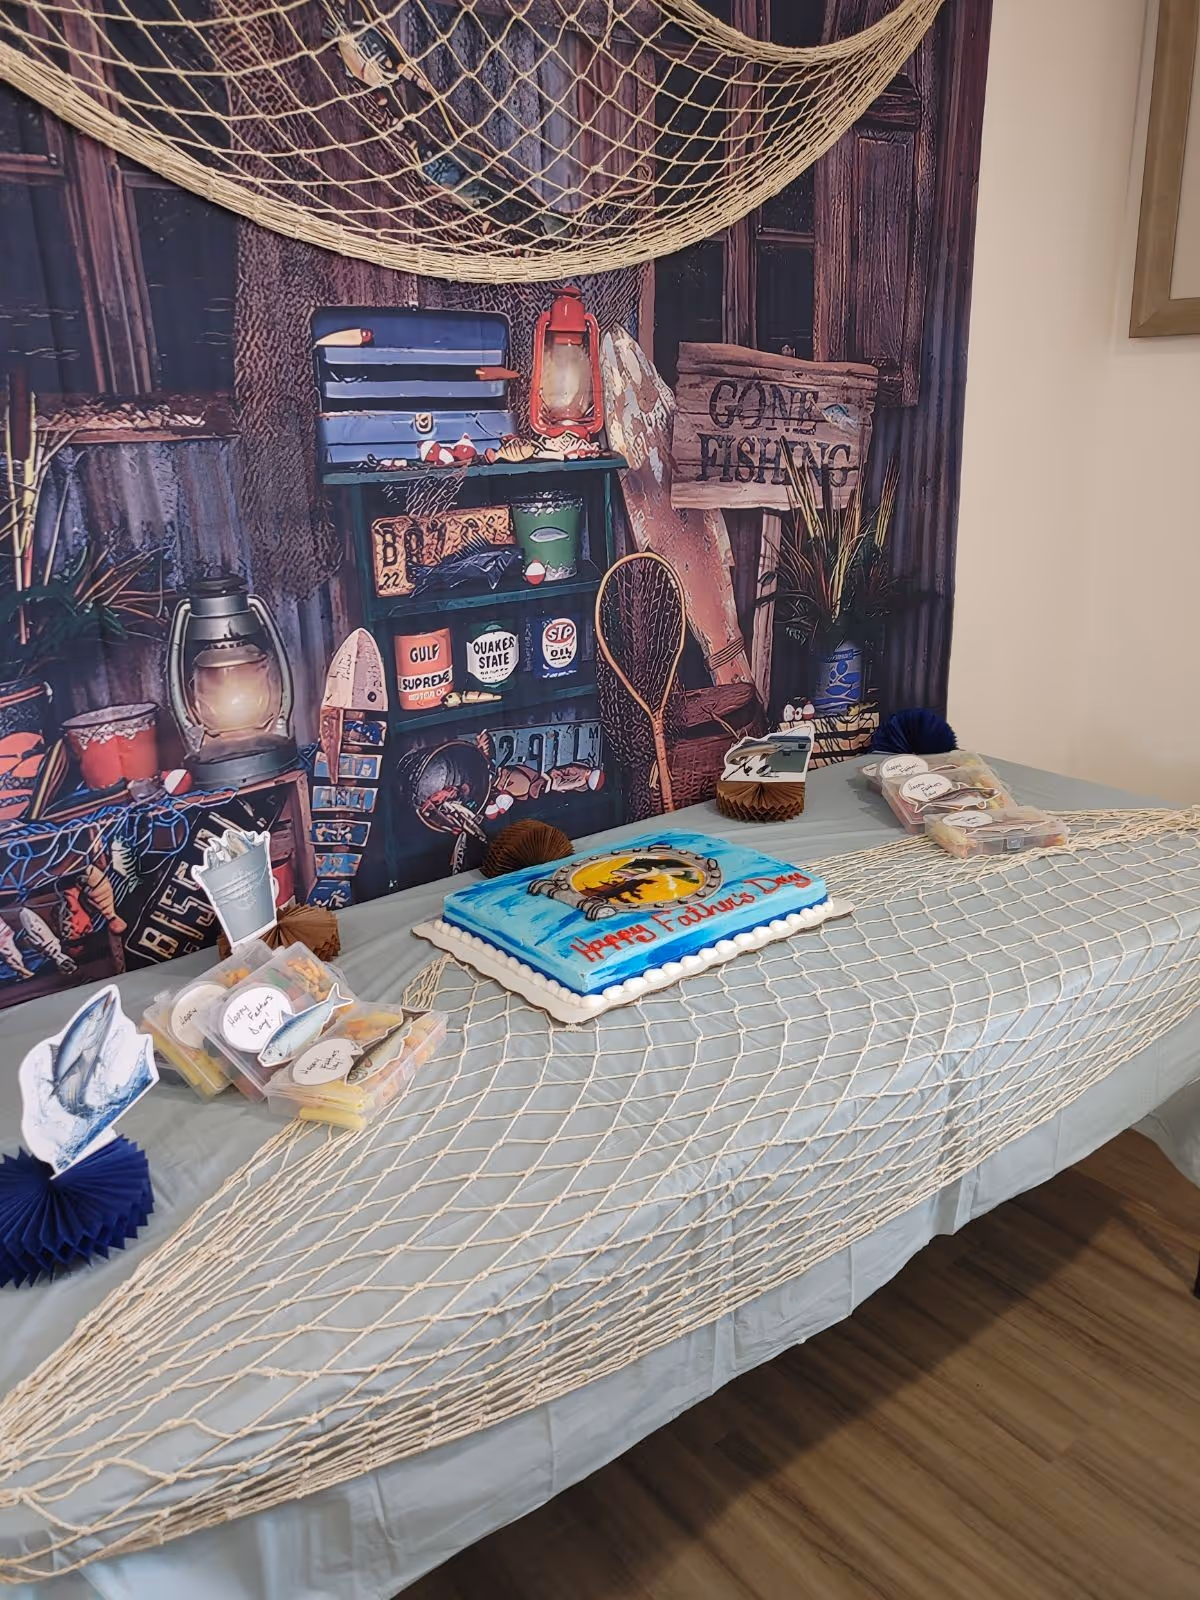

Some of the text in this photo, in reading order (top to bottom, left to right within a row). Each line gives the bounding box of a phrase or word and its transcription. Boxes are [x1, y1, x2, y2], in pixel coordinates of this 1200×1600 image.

[709, 379, 819, 436] GONE
[546, 623, 574, 641] STP
[409, 643, 440, 663] GULF
[478, 651, 510, 670] STATE
[570, 870, 812, 963] Happy Father's Day
[227, 1004, 250, 1027] Happy
